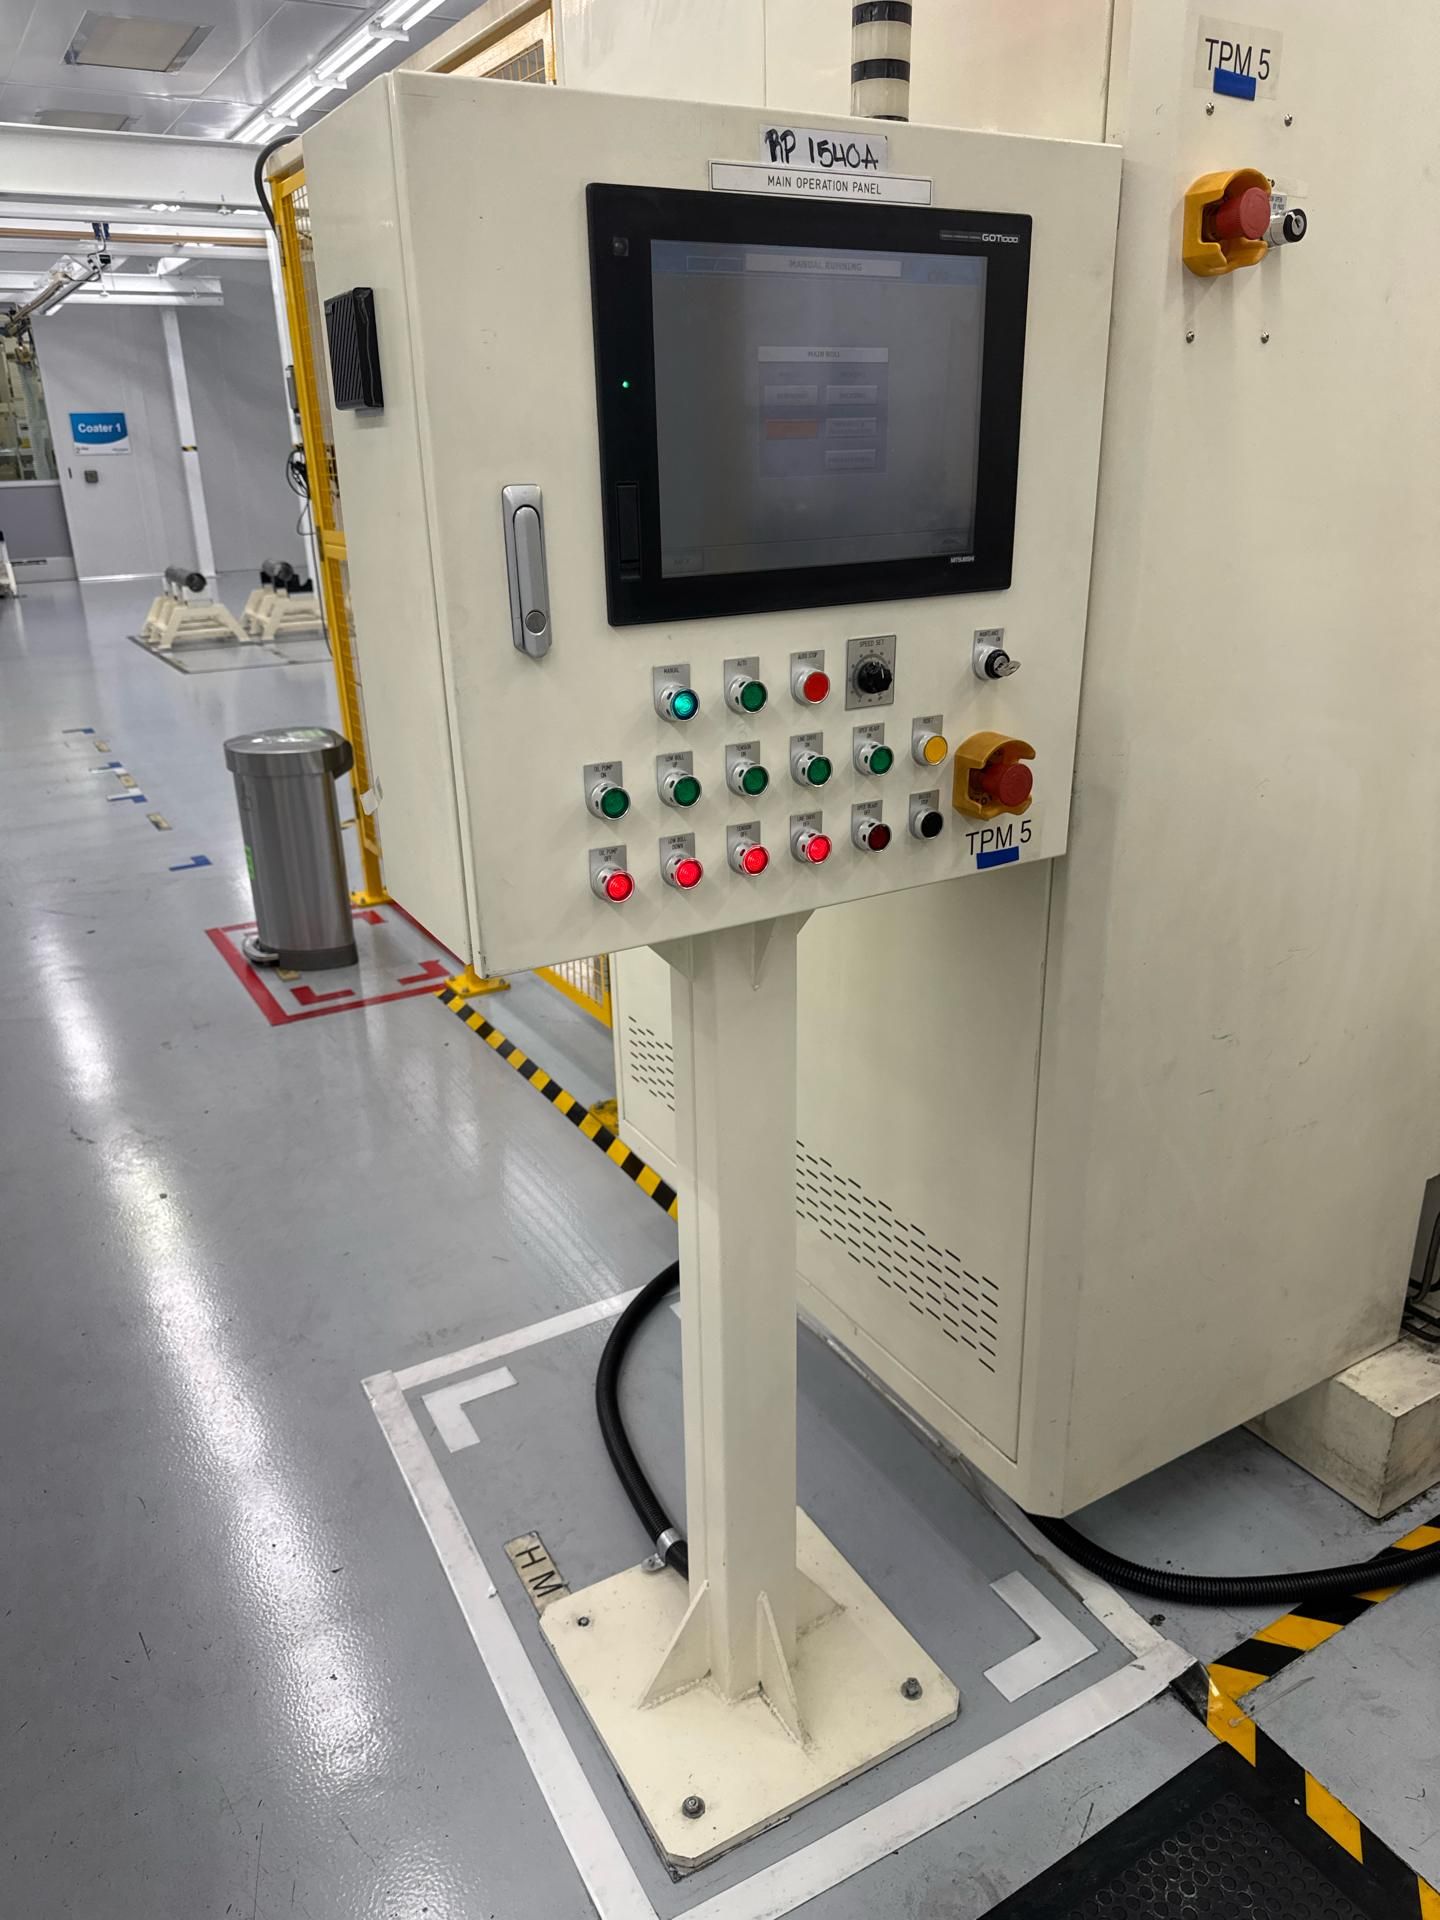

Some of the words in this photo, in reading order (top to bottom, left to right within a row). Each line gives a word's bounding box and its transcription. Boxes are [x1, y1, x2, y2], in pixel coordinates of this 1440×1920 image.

[1205, 38, 1252, 77] TPM
[1258, 48, 1271, 80] 5
[808, 136, 879, 170] 1540A
[767, 175, 792, 188] MAIN
[796, 177, 849, 192] OPERATION
[852, 183, 882, 195] PANEL
[78, 423, 113, 433] Coater
[115, 422, 121, 433] 1
[965, 824, 1012, 855] TPM
[1020, 819, 1031, 843] 5
